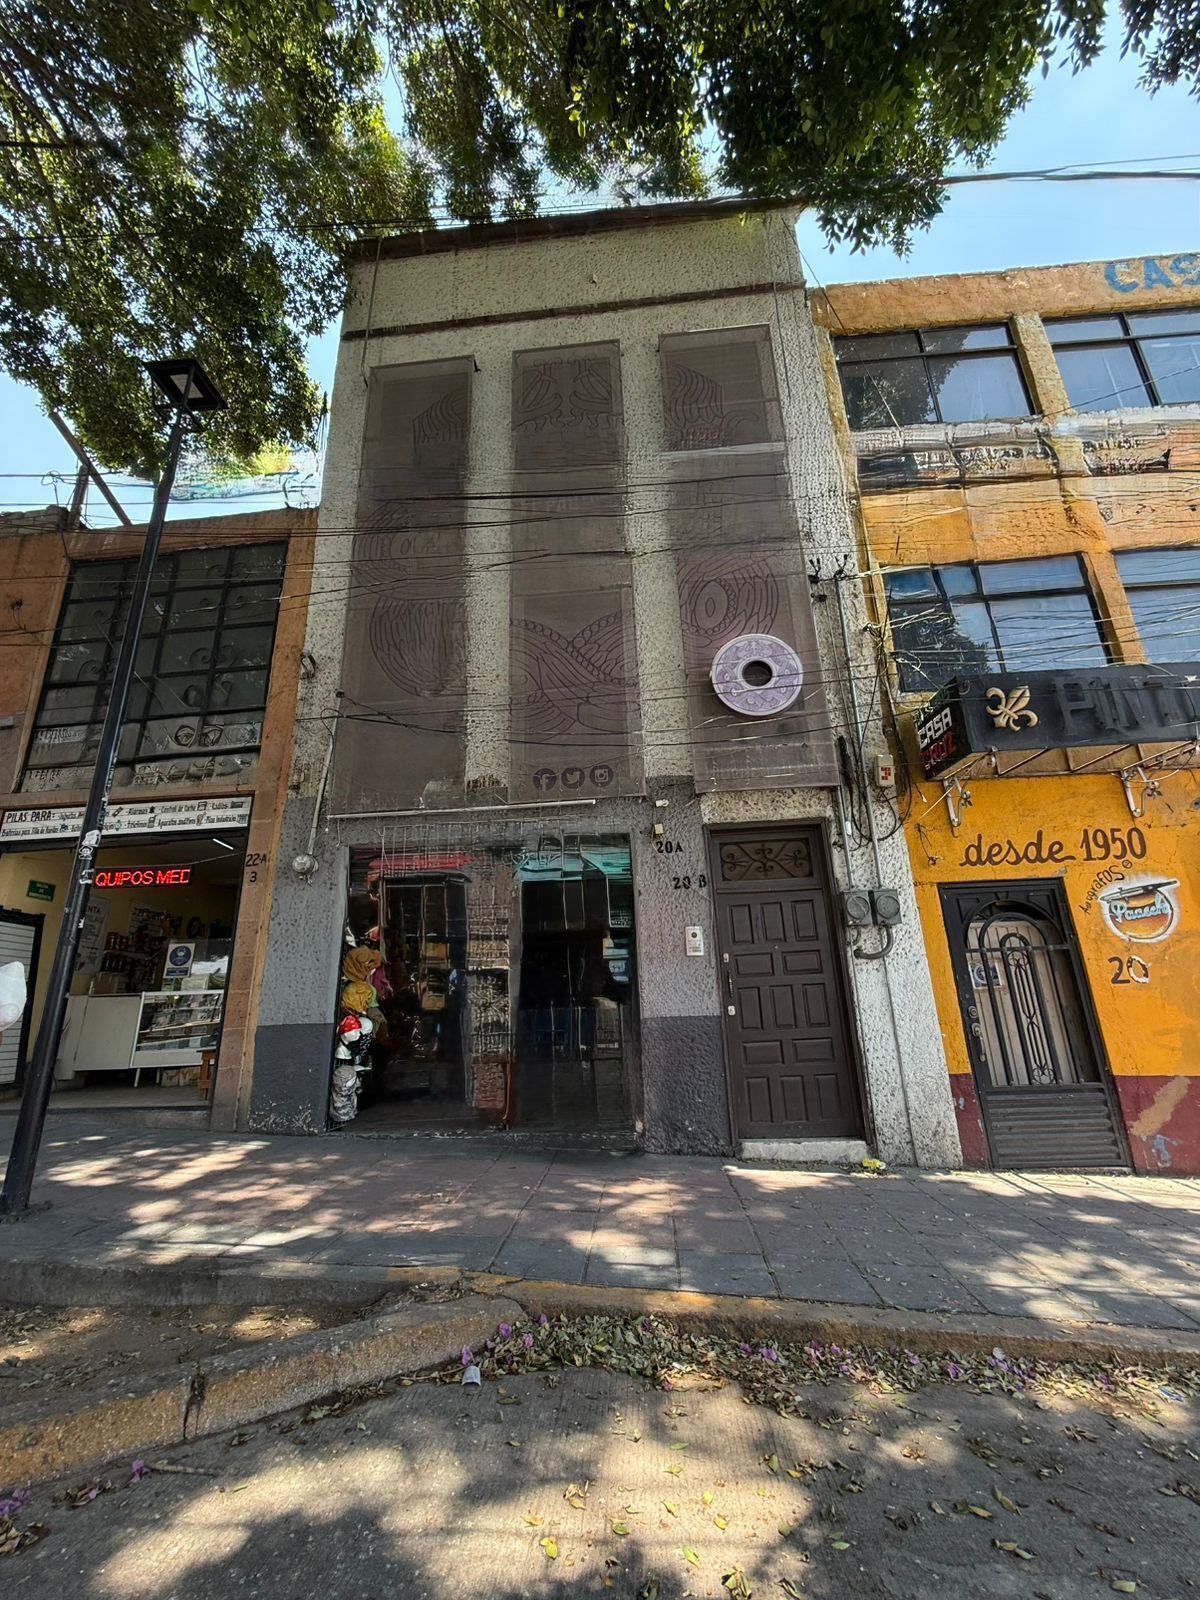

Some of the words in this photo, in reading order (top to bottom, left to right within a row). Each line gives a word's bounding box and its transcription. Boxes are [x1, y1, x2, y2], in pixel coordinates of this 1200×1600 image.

[918, 707, 952, 749] CASA
[6, 812, 28, 823] PILAS
[31, 810, 55, 822] PARA:
[656, 840, 683, 854] 20A
[959, 830, 1076, 867] desde
[1080, 827, 1147, 861] 1950
[249, 871, 257, 883] 3
[1108, 955, 1150, 985] 20
